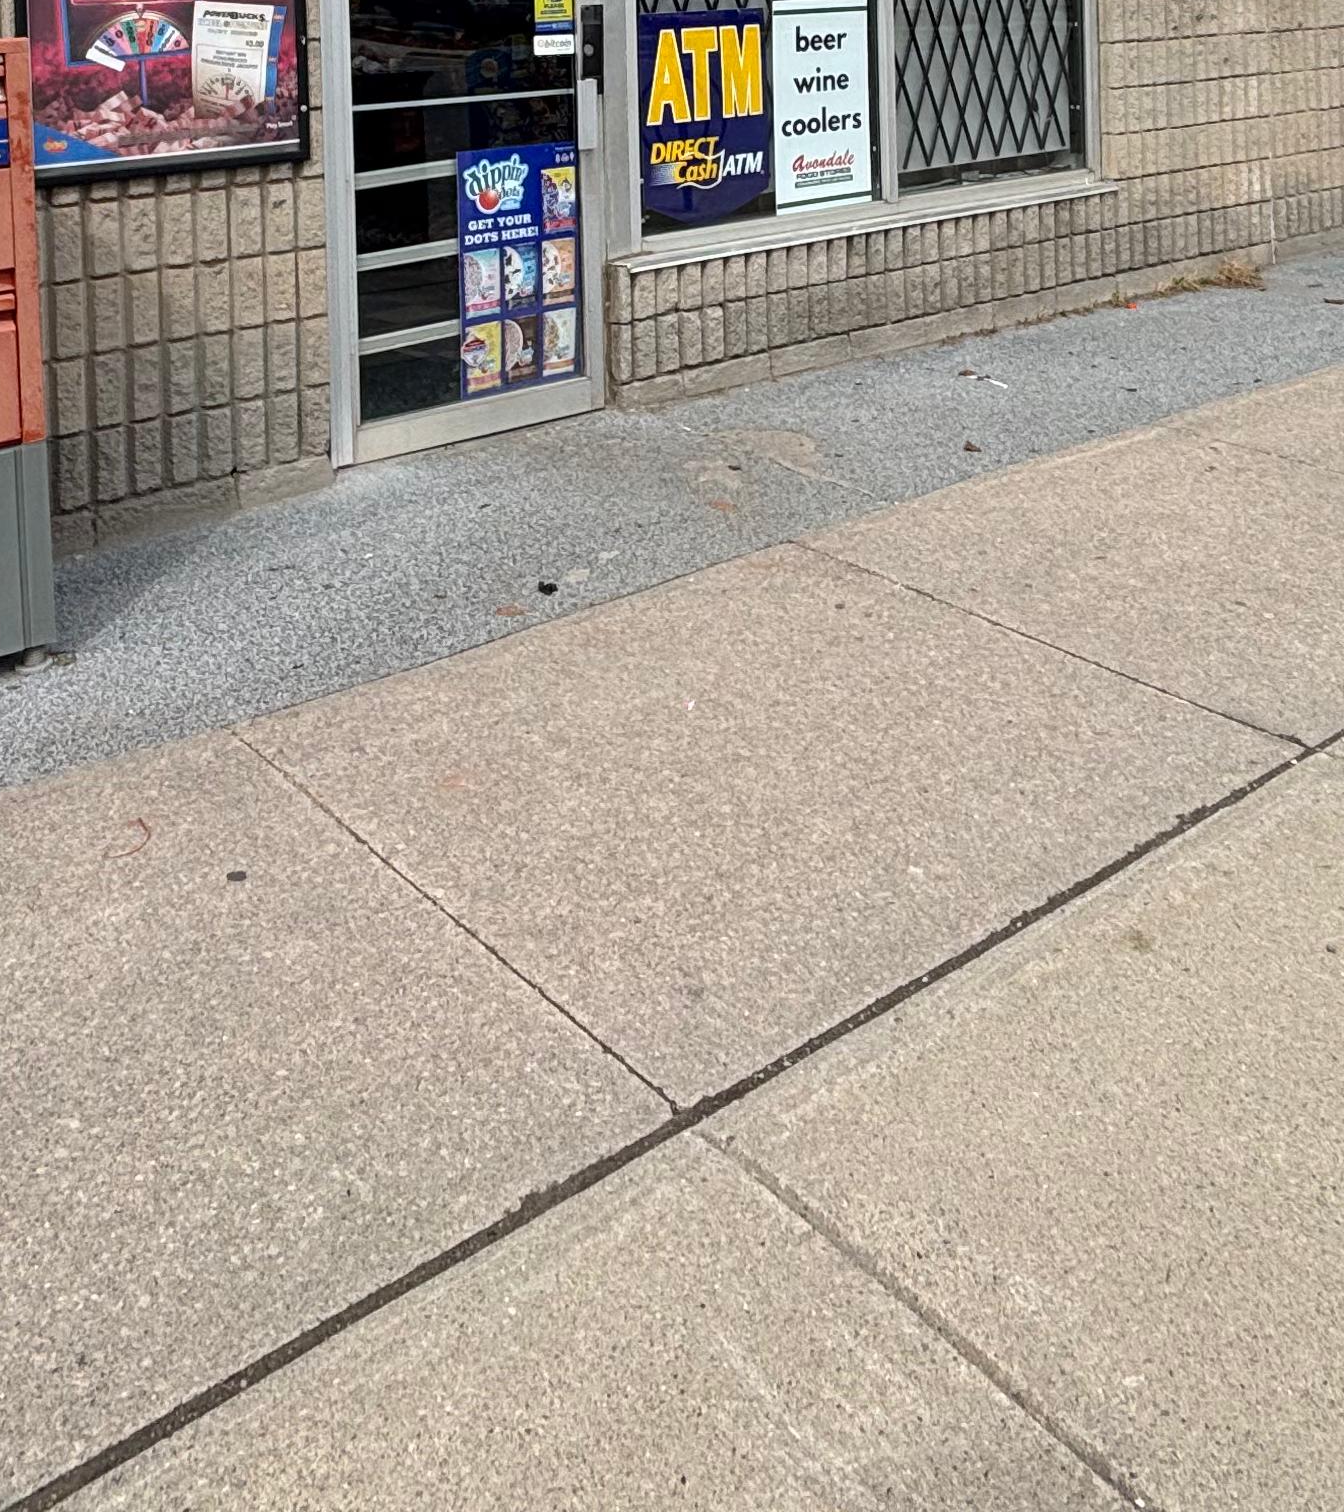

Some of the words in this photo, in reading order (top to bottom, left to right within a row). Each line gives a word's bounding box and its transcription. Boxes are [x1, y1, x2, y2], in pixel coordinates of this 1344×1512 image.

[795, 25, 847, 53] beer
[646, 23, 764, 126] ATM
[793, 67, 849, 94] wine
[781, 106, 862, 137] coolers
[650, 135, 719, 165] DIRECT
[792, 148, 855, 173] Avondale
[672, 161, 718, 183] Cash
[722, 151, 764, 177] ATM
[464, 231, 498, 246] DOTS
[501, 226, 539, 241] HERE!
[468, 218, 494, 231] GET
[496, 213, 532, 228] YOUR
